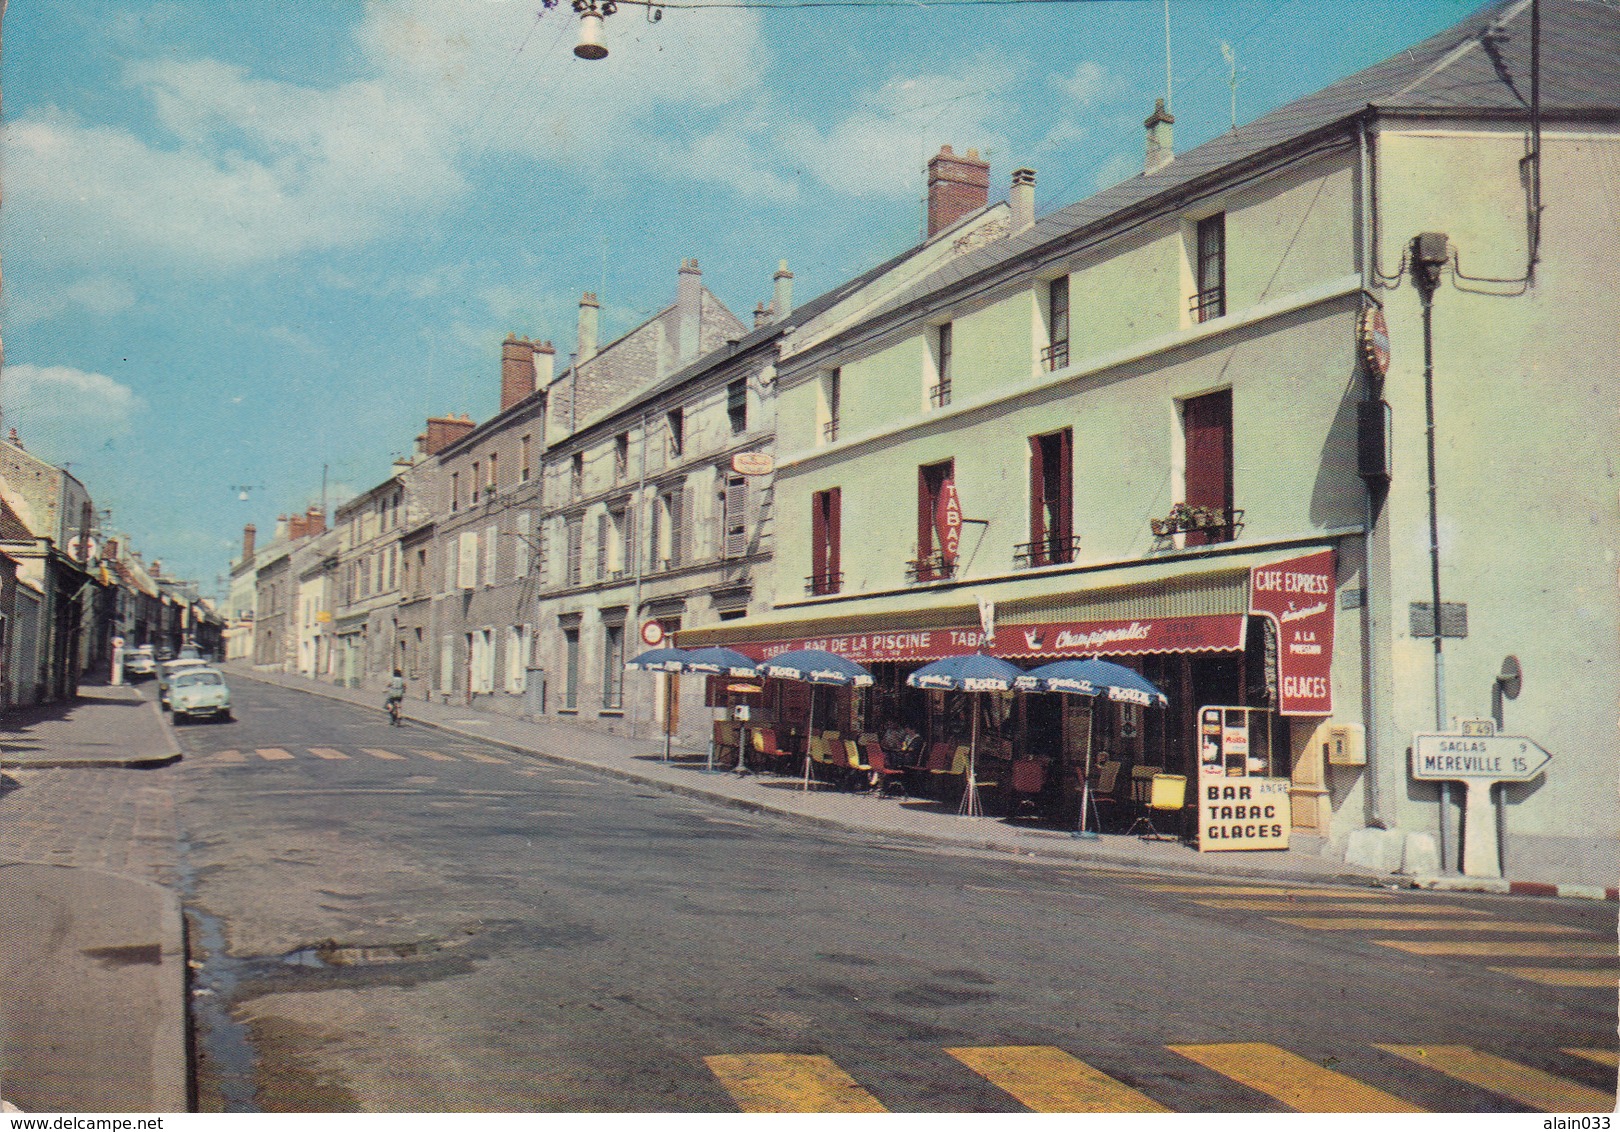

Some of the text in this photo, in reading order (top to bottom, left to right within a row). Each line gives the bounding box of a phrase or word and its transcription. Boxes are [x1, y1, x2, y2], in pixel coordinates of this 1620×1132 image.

[947, 485, 960, 553] TABAC
[1256, 571, 1329, 594] CAFE EXPRESS
[804, 639, 827, 652] BAR
[831, 637, 848, 652] DE
[852, 636, 868, 650] LA
[872, 632, 931, 650] PISCINE
[1303, 631, 1316, 642] LA
[1284, 676, 1327, 698] GLACES
[1439, 741, 1487, 752] SACLAS
[1425, 755, 1528, 772] MEREVILLE 15
[1207, 785, 1252, 800] BAR
[1208, 805, 1275, 820] TABAC
[1208, 824, 1282, 839] GLACES
